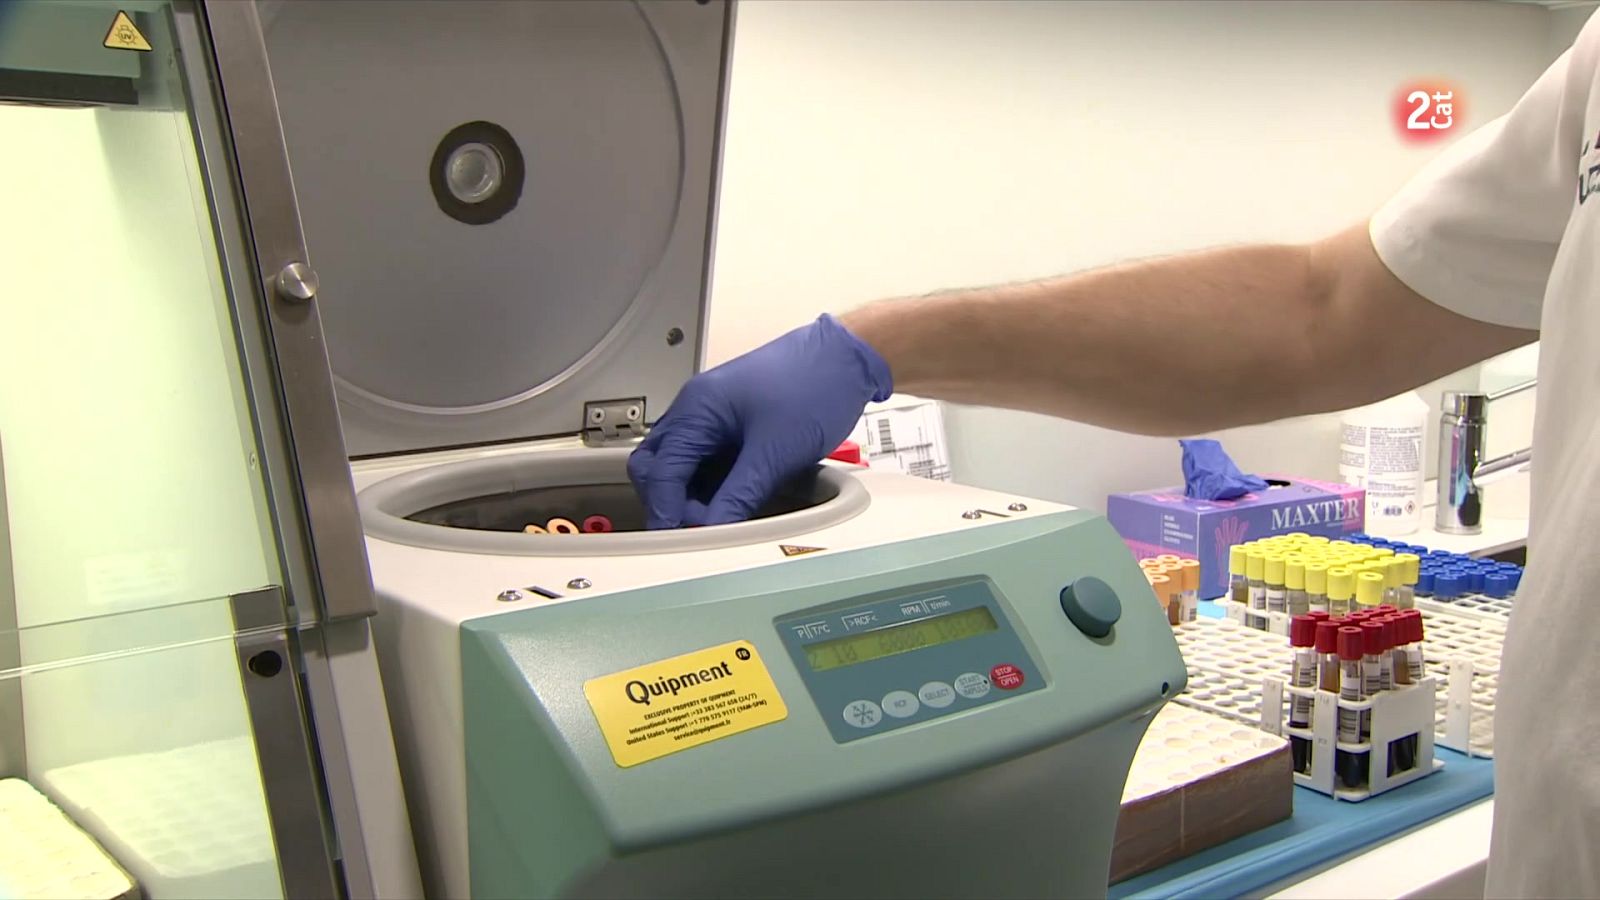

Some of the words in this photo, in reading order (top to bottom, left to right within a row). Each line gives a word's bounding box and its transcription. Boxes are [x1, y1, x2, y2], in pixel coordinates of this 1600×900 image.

[1271, 497, 1360, 531] MAXTER
[901, 604, 922, 616] RPM
[994, 665, 1012, 677] STOP
[1001, 675, 1019, 687] OPEN
[625, 661, 732, 705] Quipment
[924, 688, 950, 701] SELECT
[643, 707, 672, 720] EXCLUSIVE
[671, 699, 700, 712] PROPERTY
[708, 689, 736, 701] QUIPMENT
[626, 734, 646, 745] United
[646, 728, 665, 739] States
[664, 721, 688, 734] Support
[628, 718, 667, 734] International
[667, 711, 690, 723] Support
